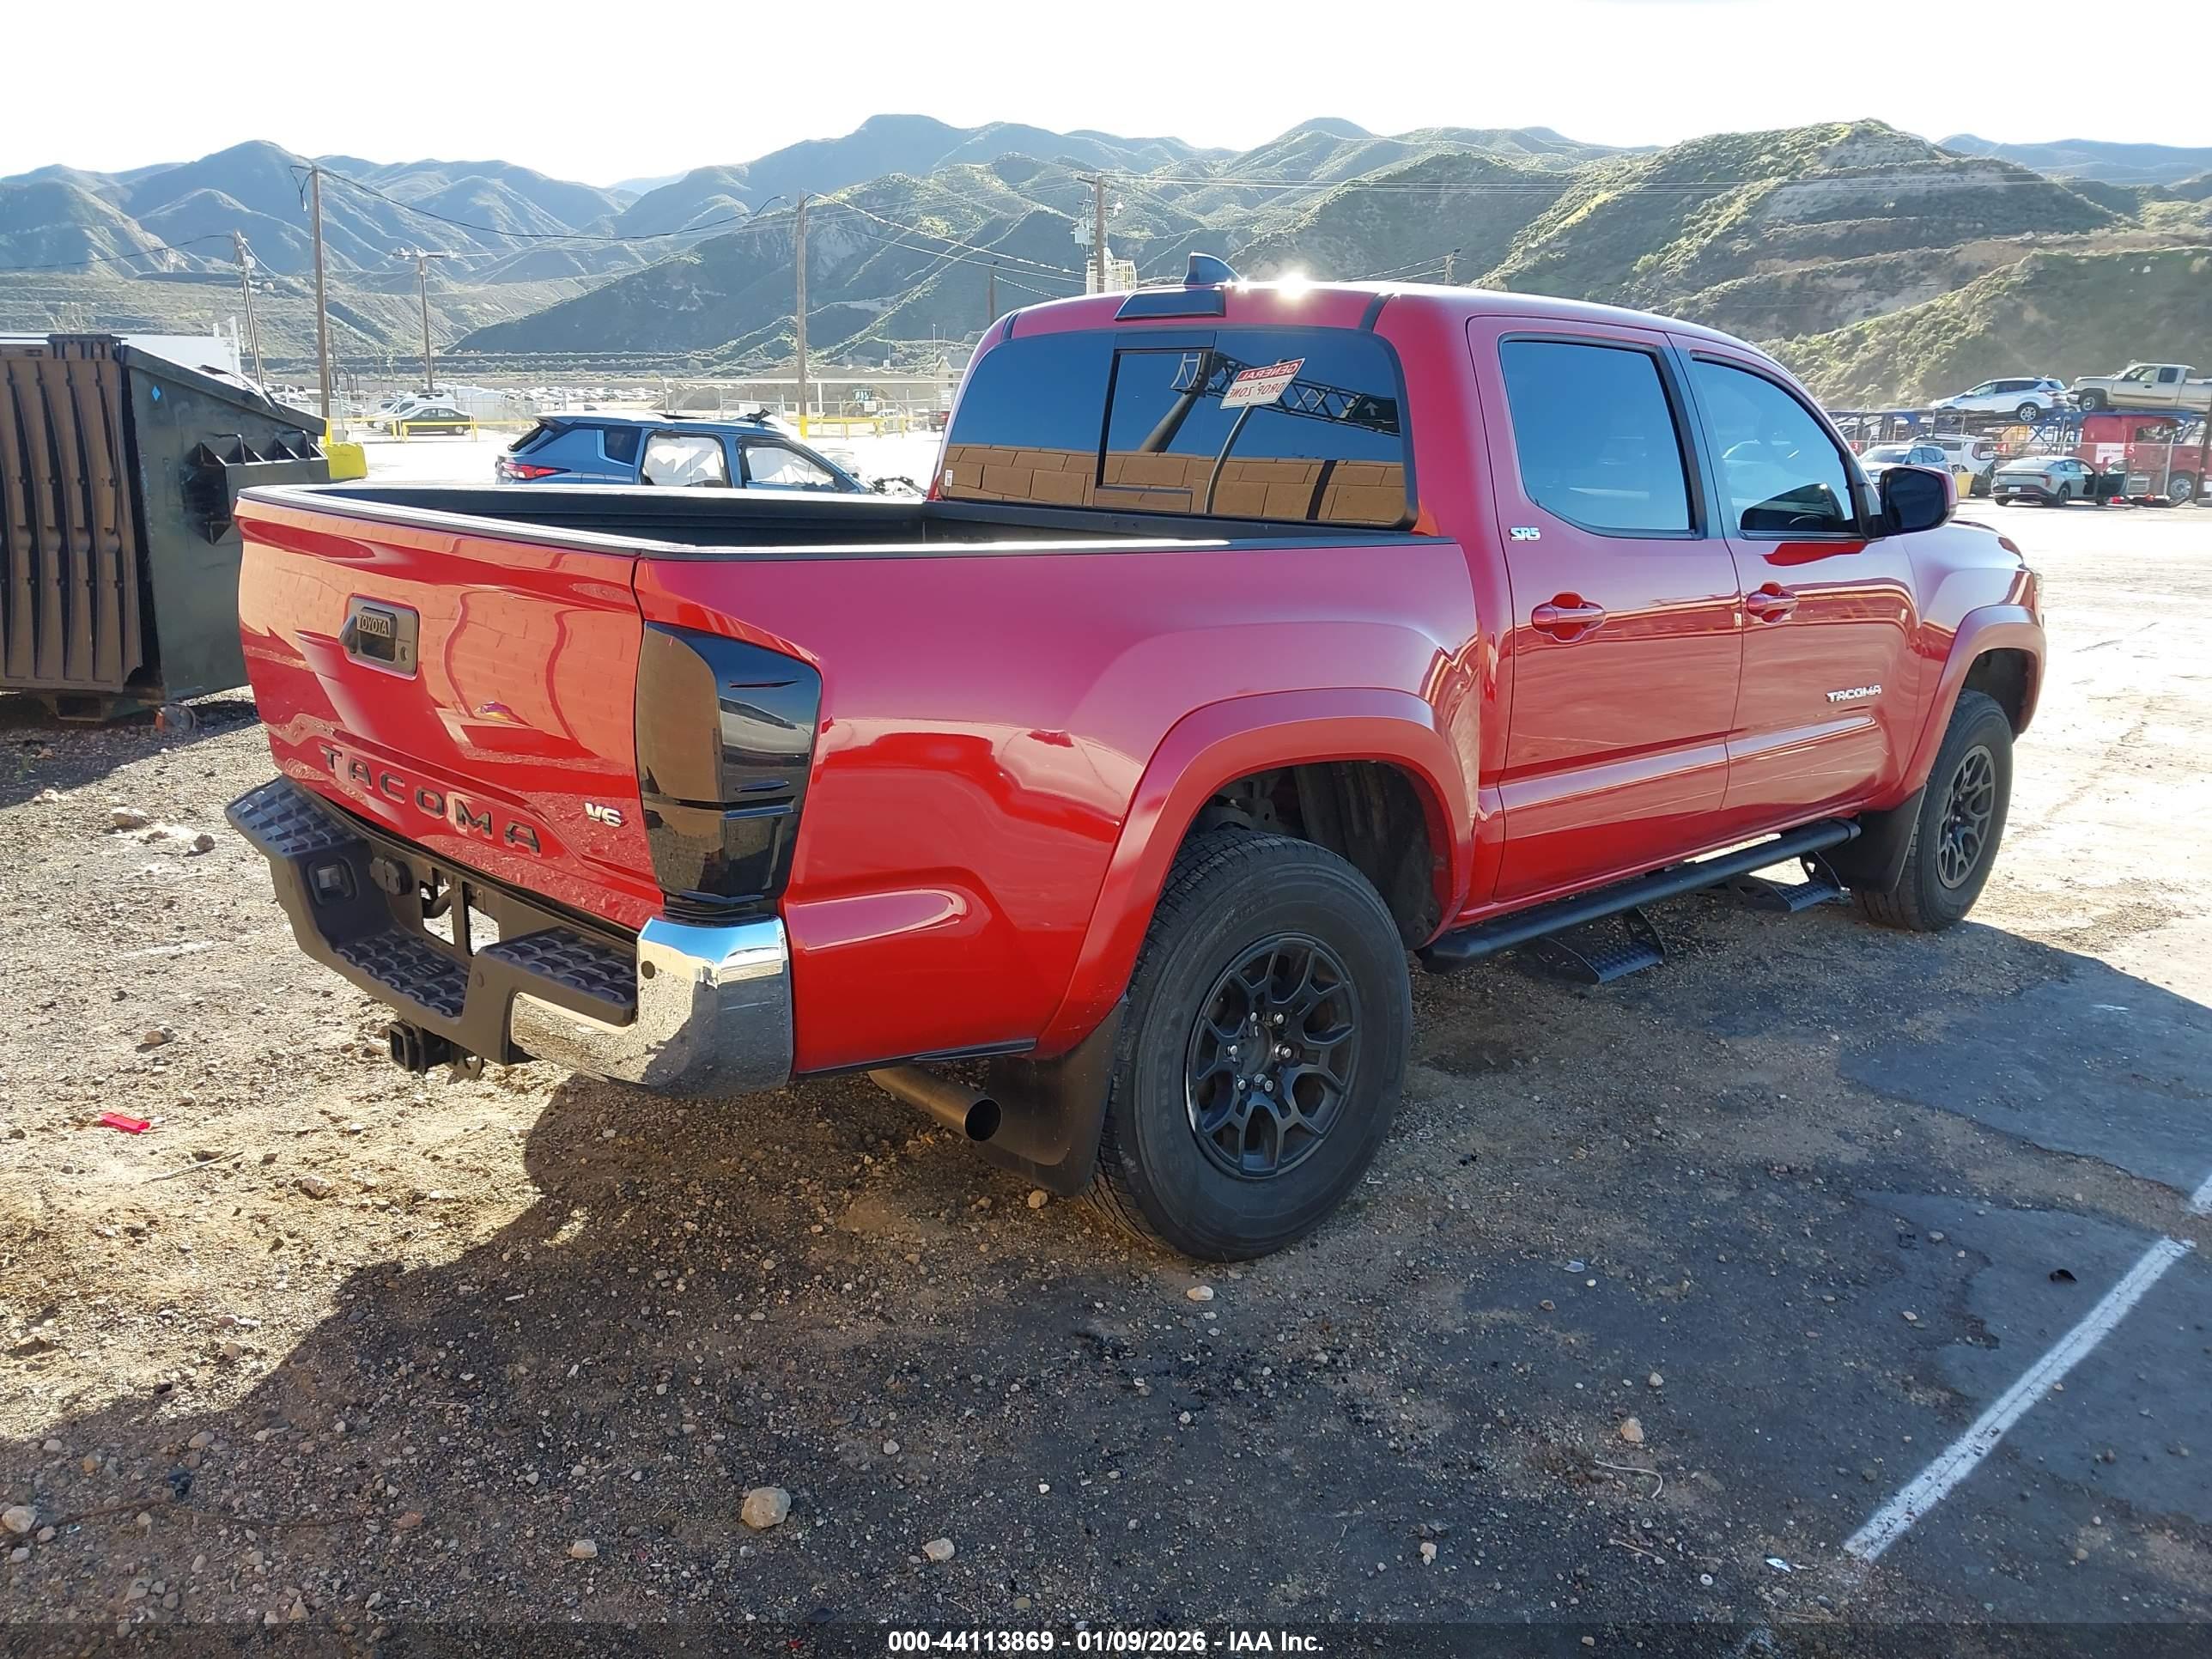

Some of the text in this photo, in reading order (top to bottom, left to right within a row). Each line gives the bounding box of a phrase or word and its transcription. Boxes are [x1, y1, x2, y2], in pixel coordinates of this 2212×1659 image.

[1852, 442, 1858, 451] 3
[2127, 445, 2135, 453] 5
[1510, 527, 1540, 541] SR5
[357, 616, 387, 635] TOYOTA
[1826, 684, 1881, 702] TACOMA
[319, 745, 542, 857] TACOMA
[585, 802, 623, 828] V6
